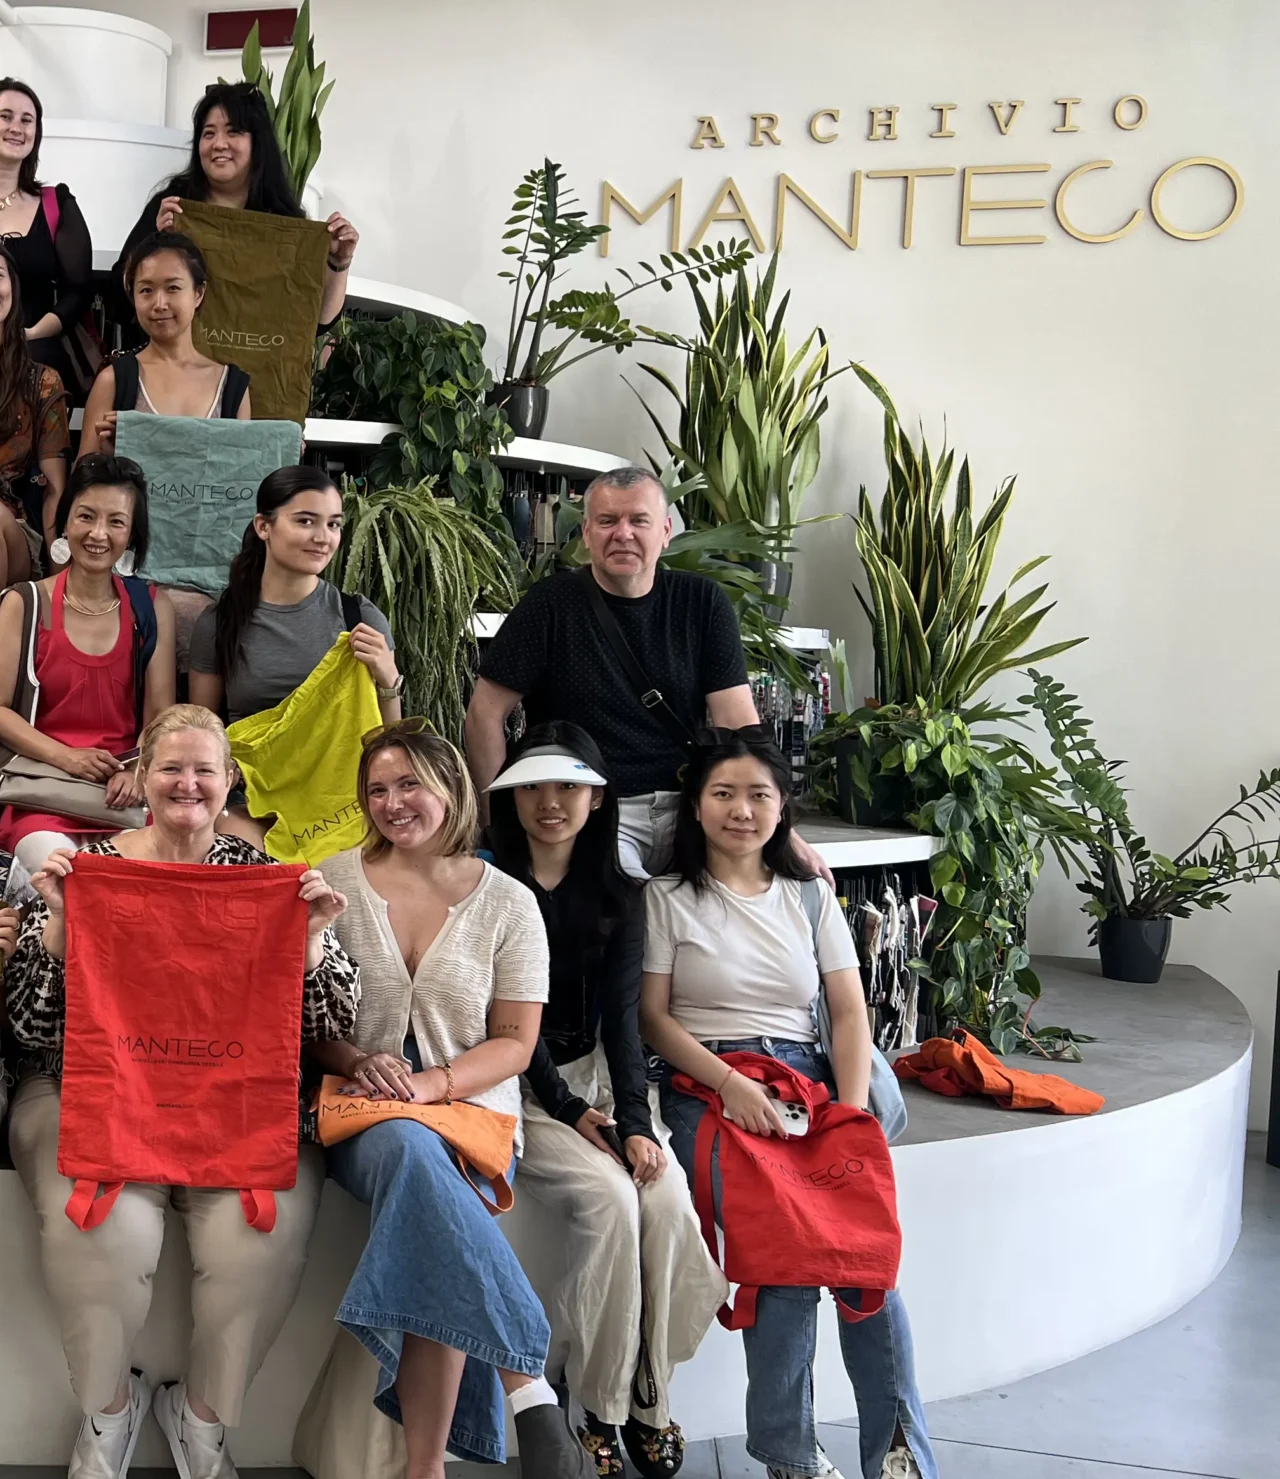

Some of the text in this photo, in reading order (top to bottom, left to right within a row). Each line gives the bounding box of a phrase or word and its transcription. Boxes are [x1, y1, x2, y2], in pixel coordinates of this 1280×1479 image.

[691, 94, 1149, 150] ARCHIVIO
[600, 156, 1245, 258] MANTECO
[150, 482, 254, 501] MANTECO
[117, 1035, 245, 1059] MANTECO
